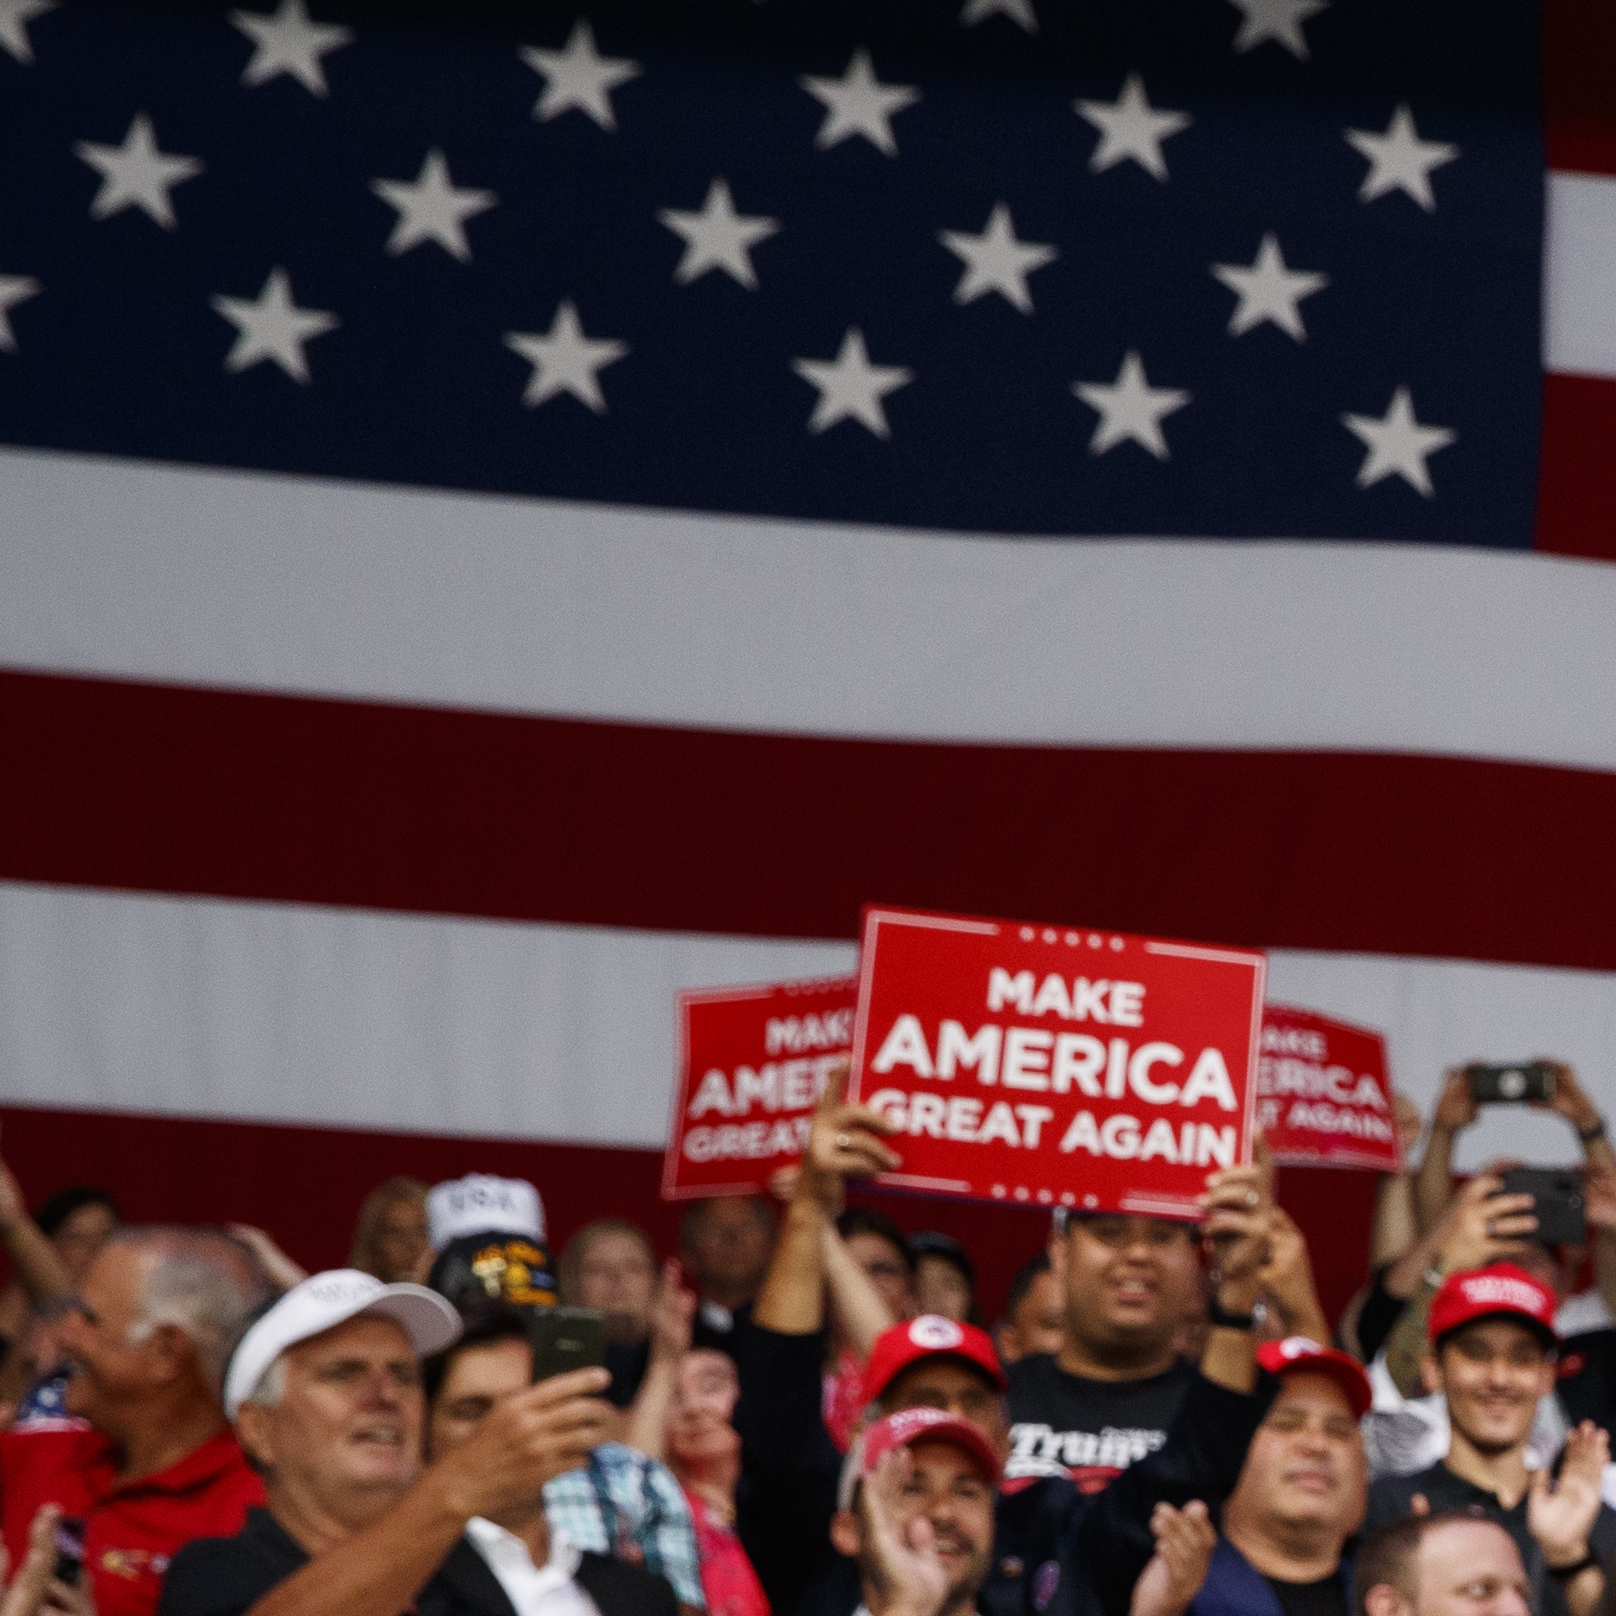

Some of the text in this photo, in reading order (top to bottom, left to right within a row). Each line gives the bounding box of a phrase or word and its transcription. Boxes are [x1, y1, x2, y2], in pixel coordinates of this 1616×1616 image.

[986, 966, 1146, 1028] MAKE
[764, 1007, 854, 1054] MAK
[1262, 1026, 1329, 1062] AKE
[871, 1013, 1239, 1112] AMERICA
[869, 1087, 1054, 1149] GREAT
[1059, 1110, 1239, 1170] AGAIN
